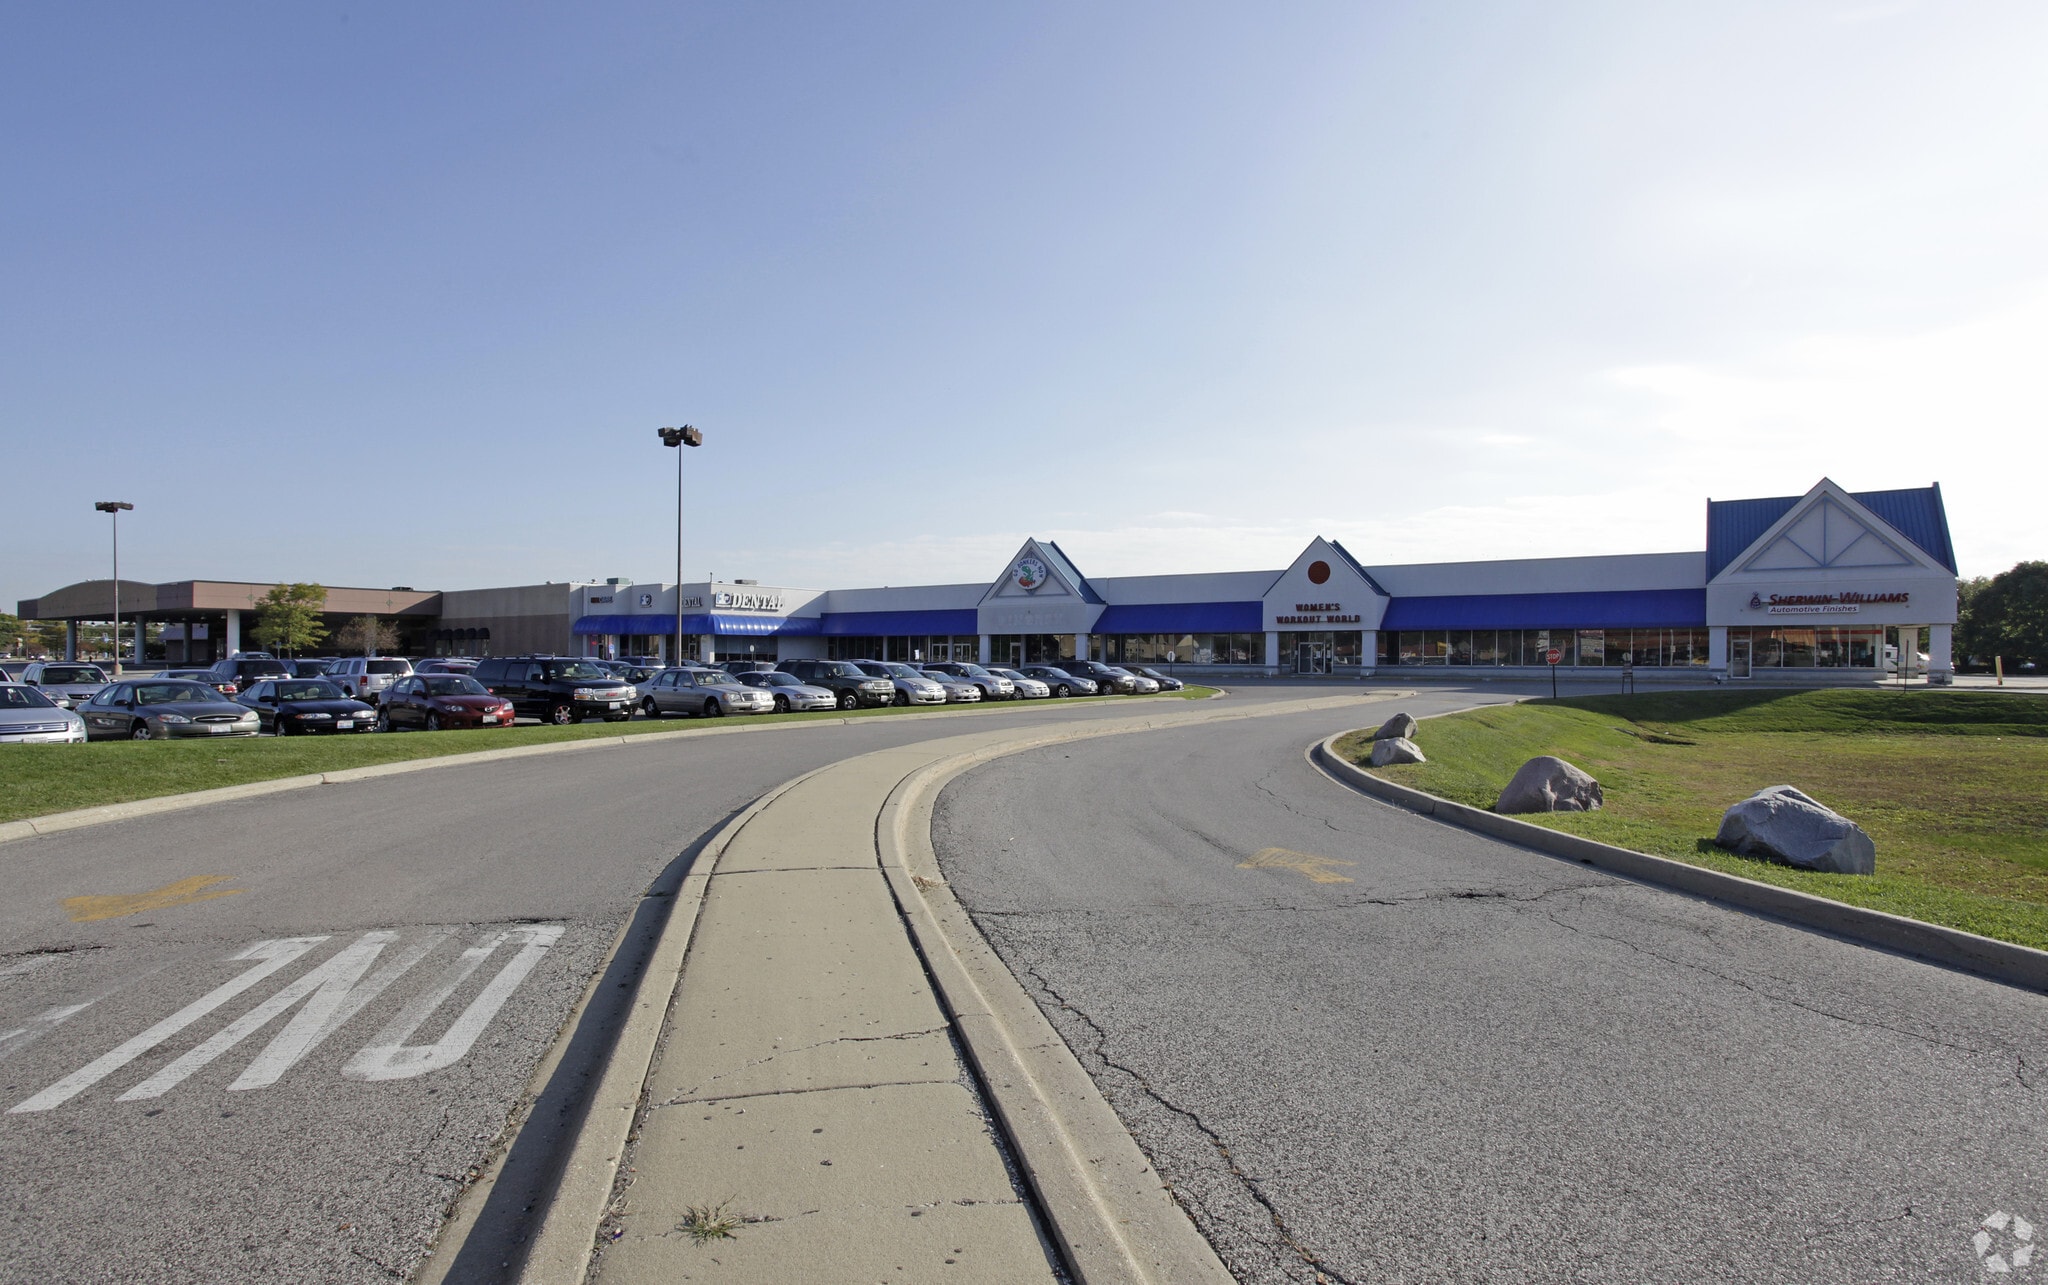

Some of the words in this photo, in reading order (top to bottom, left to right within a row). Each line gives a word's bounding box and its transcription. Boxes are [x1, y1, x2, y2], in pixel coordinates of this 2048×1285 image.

[732, 592, 783, 610] DENTAL
[1295, 603, 1341, 612] WOMEN'S
[1822, 605, 1857, 613] Finishes
[1276, 615, 1321, 624] WORKOUT
[1327, 615, 1361, 623] WORLD
